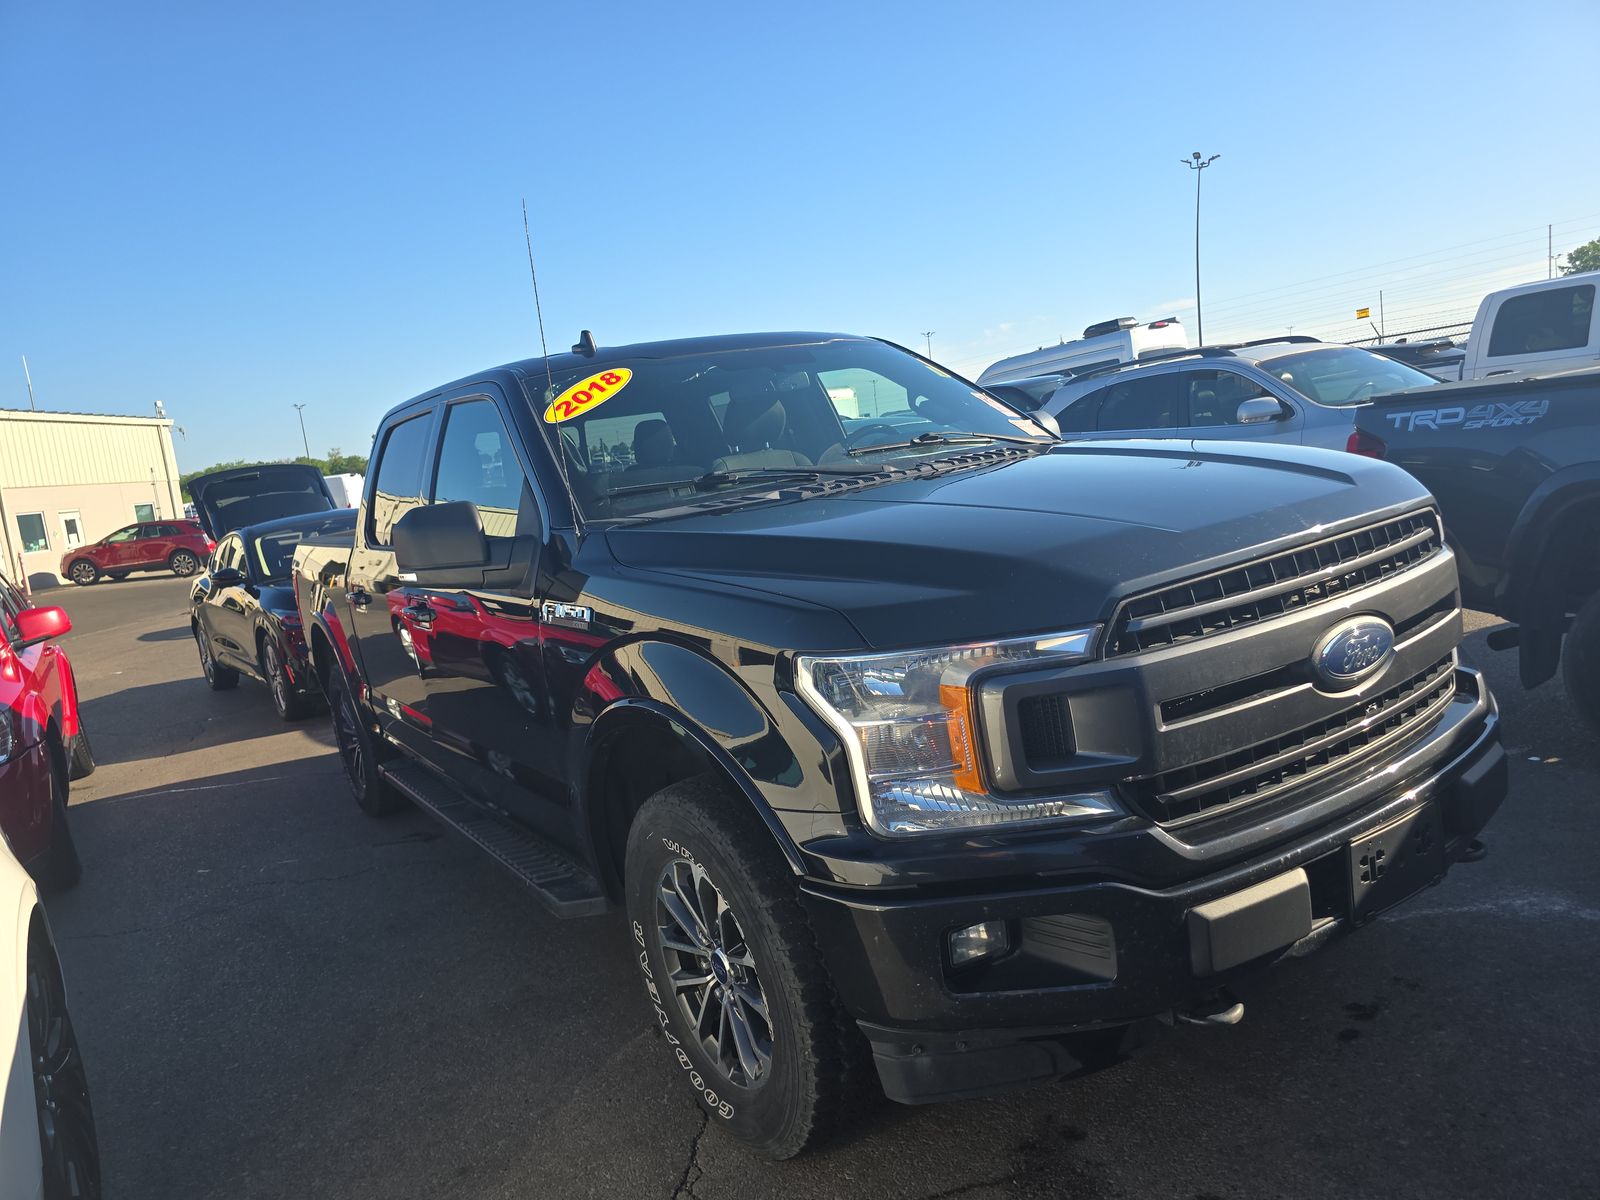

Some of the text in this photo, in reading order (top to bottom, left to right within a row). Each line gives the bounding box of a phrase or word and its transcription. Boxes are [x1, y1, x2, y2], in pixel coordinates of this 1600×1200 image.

[555, 372, 622, 417] 2018
[1386, 407, 1465, 432] TRD
[1463, 415, 1544, 430] SPORT
[633, 920, 735, 1120] GOODYEAR
